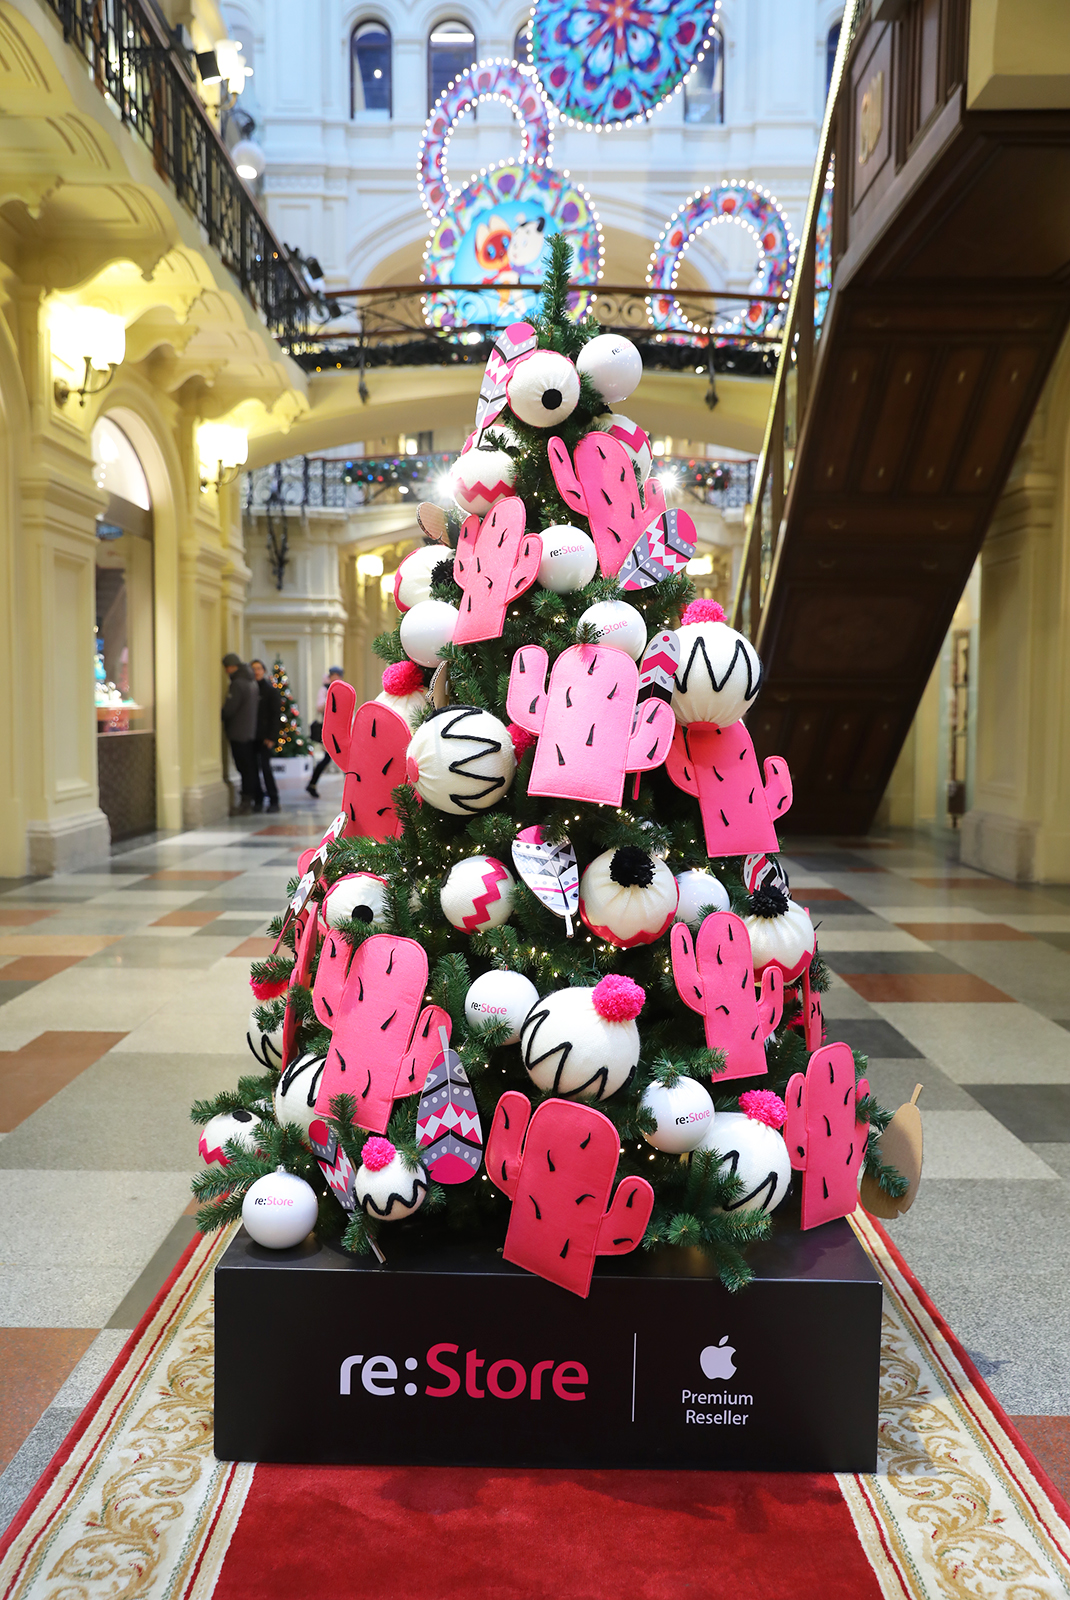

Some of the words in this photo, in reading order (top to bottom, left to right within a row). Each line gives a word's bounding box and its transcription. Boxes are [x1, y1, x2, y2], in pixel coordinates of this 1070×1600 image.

[550, 544, 585, 558] re:Store
[470, 1001, 508, 1015] re:Store
[675, 1109, 710, 1125] re:Store
[254, 1195, 294, 1207] re:Store
[339, 1342, 590, 1402] re:Store
[681, 1389, 754, 1406] Premium
[685, 1409, 749, 1425] Reseller
